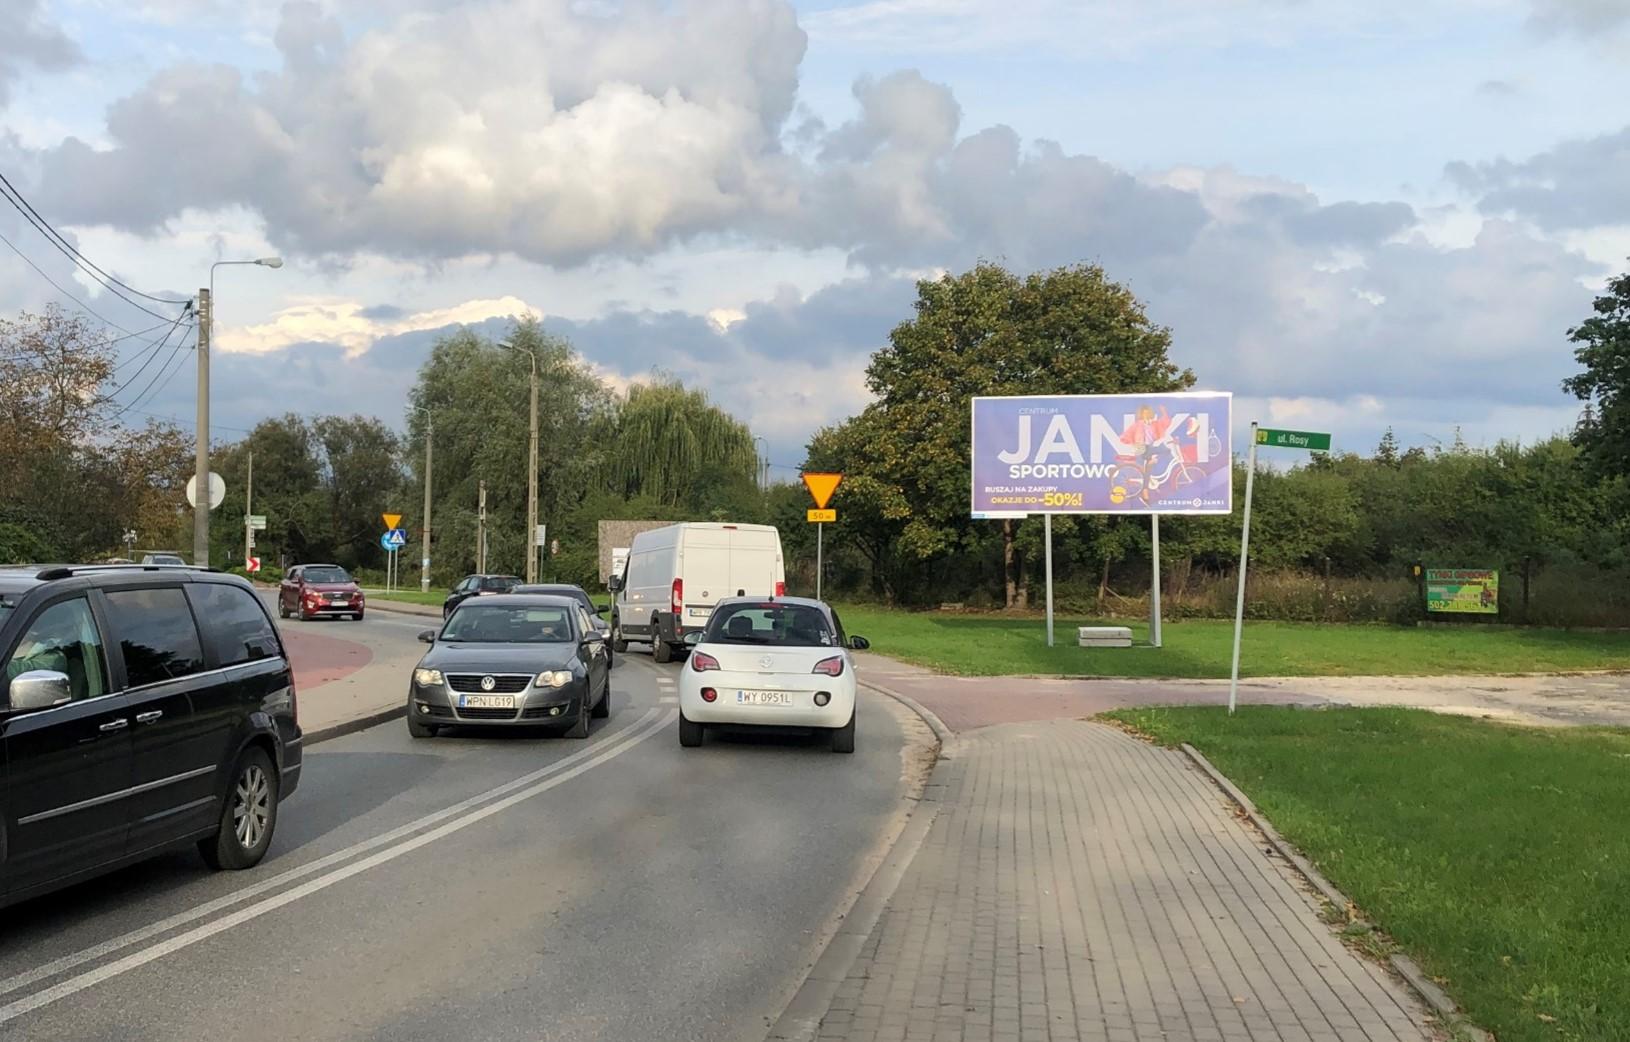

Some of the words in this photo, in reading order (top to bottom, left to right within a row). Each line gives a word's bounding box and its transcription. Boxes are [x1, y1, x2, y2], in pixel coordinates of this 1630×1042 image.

[1277, 434, 1287, 443] ul.
[1289, 434, 1309, 447] Rosy
[467, 697, 486, 706] WPN
[744, 692, 757, 702] WY
[761, 692, 791, 703] 0951L
